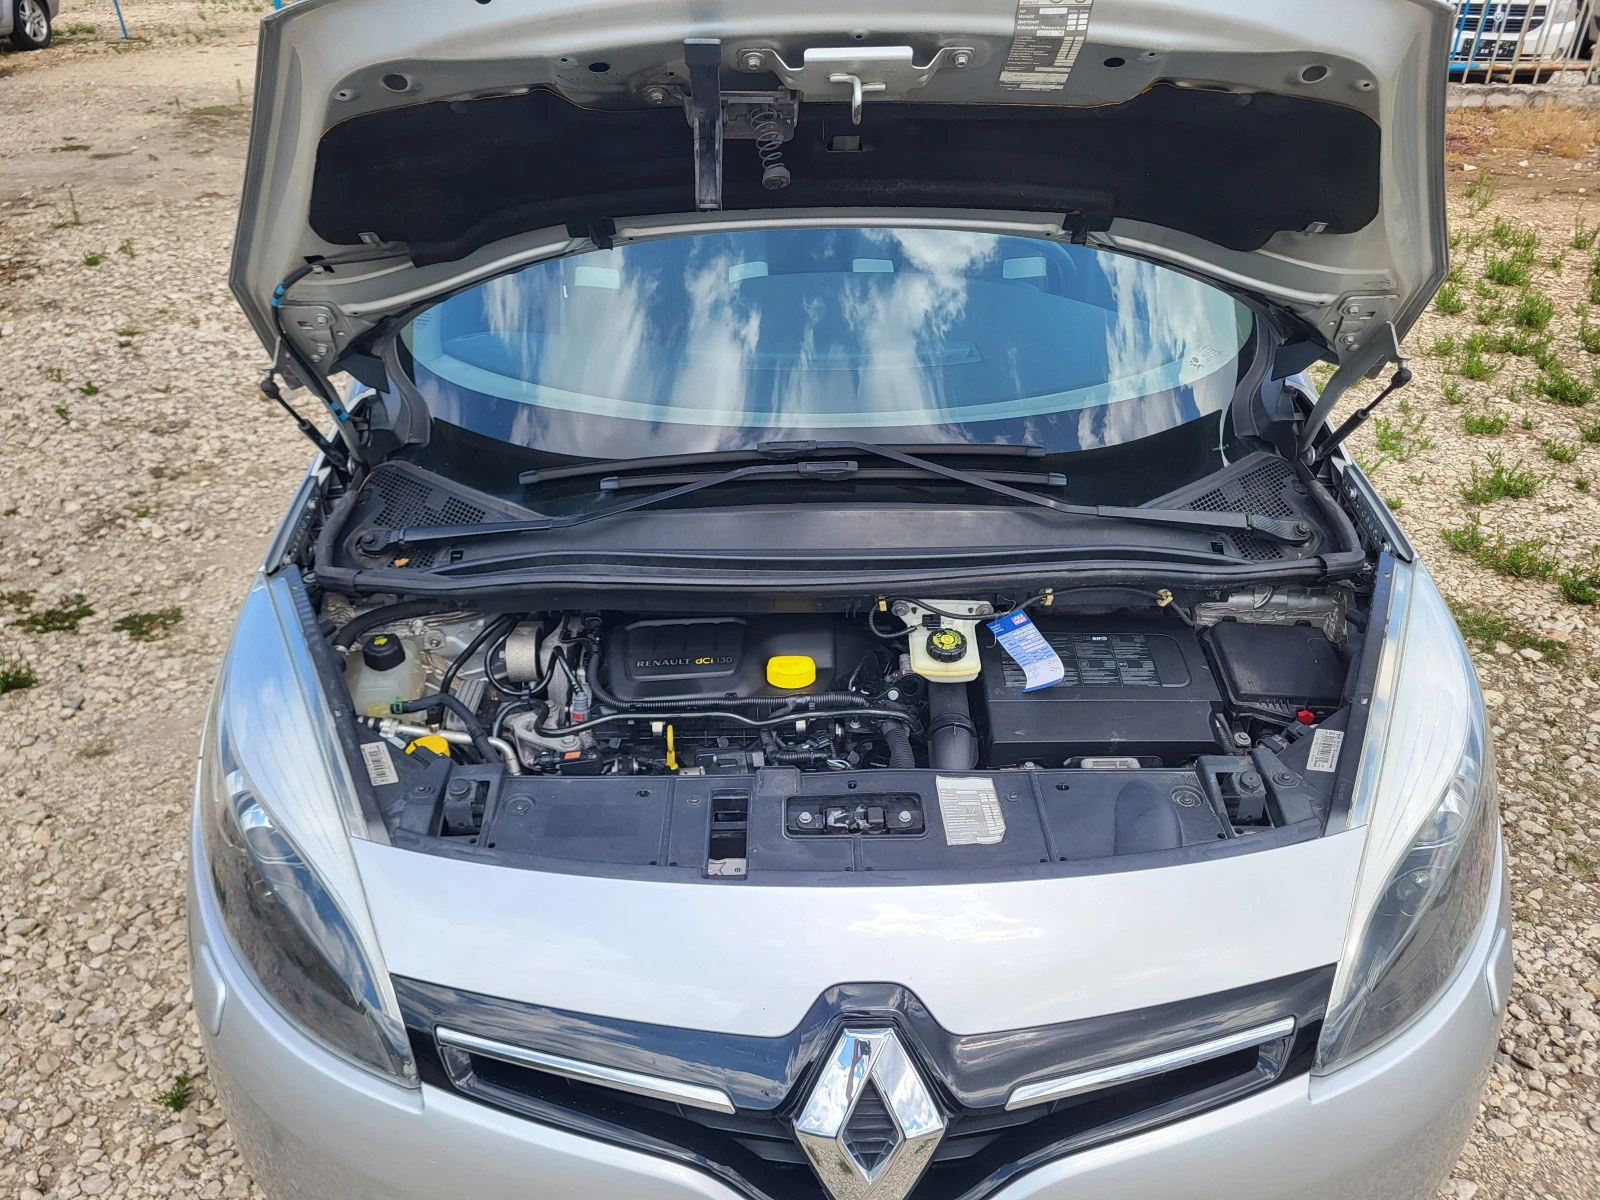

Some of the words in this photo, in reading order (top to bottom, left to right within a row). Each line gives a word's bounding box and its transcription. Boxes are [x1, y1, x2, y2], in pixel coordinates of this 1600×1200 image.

[636, 658, 691, 667] RENAULT
[695, 657, 714, 665] dCi
[716, 656, 733, 664] 130
